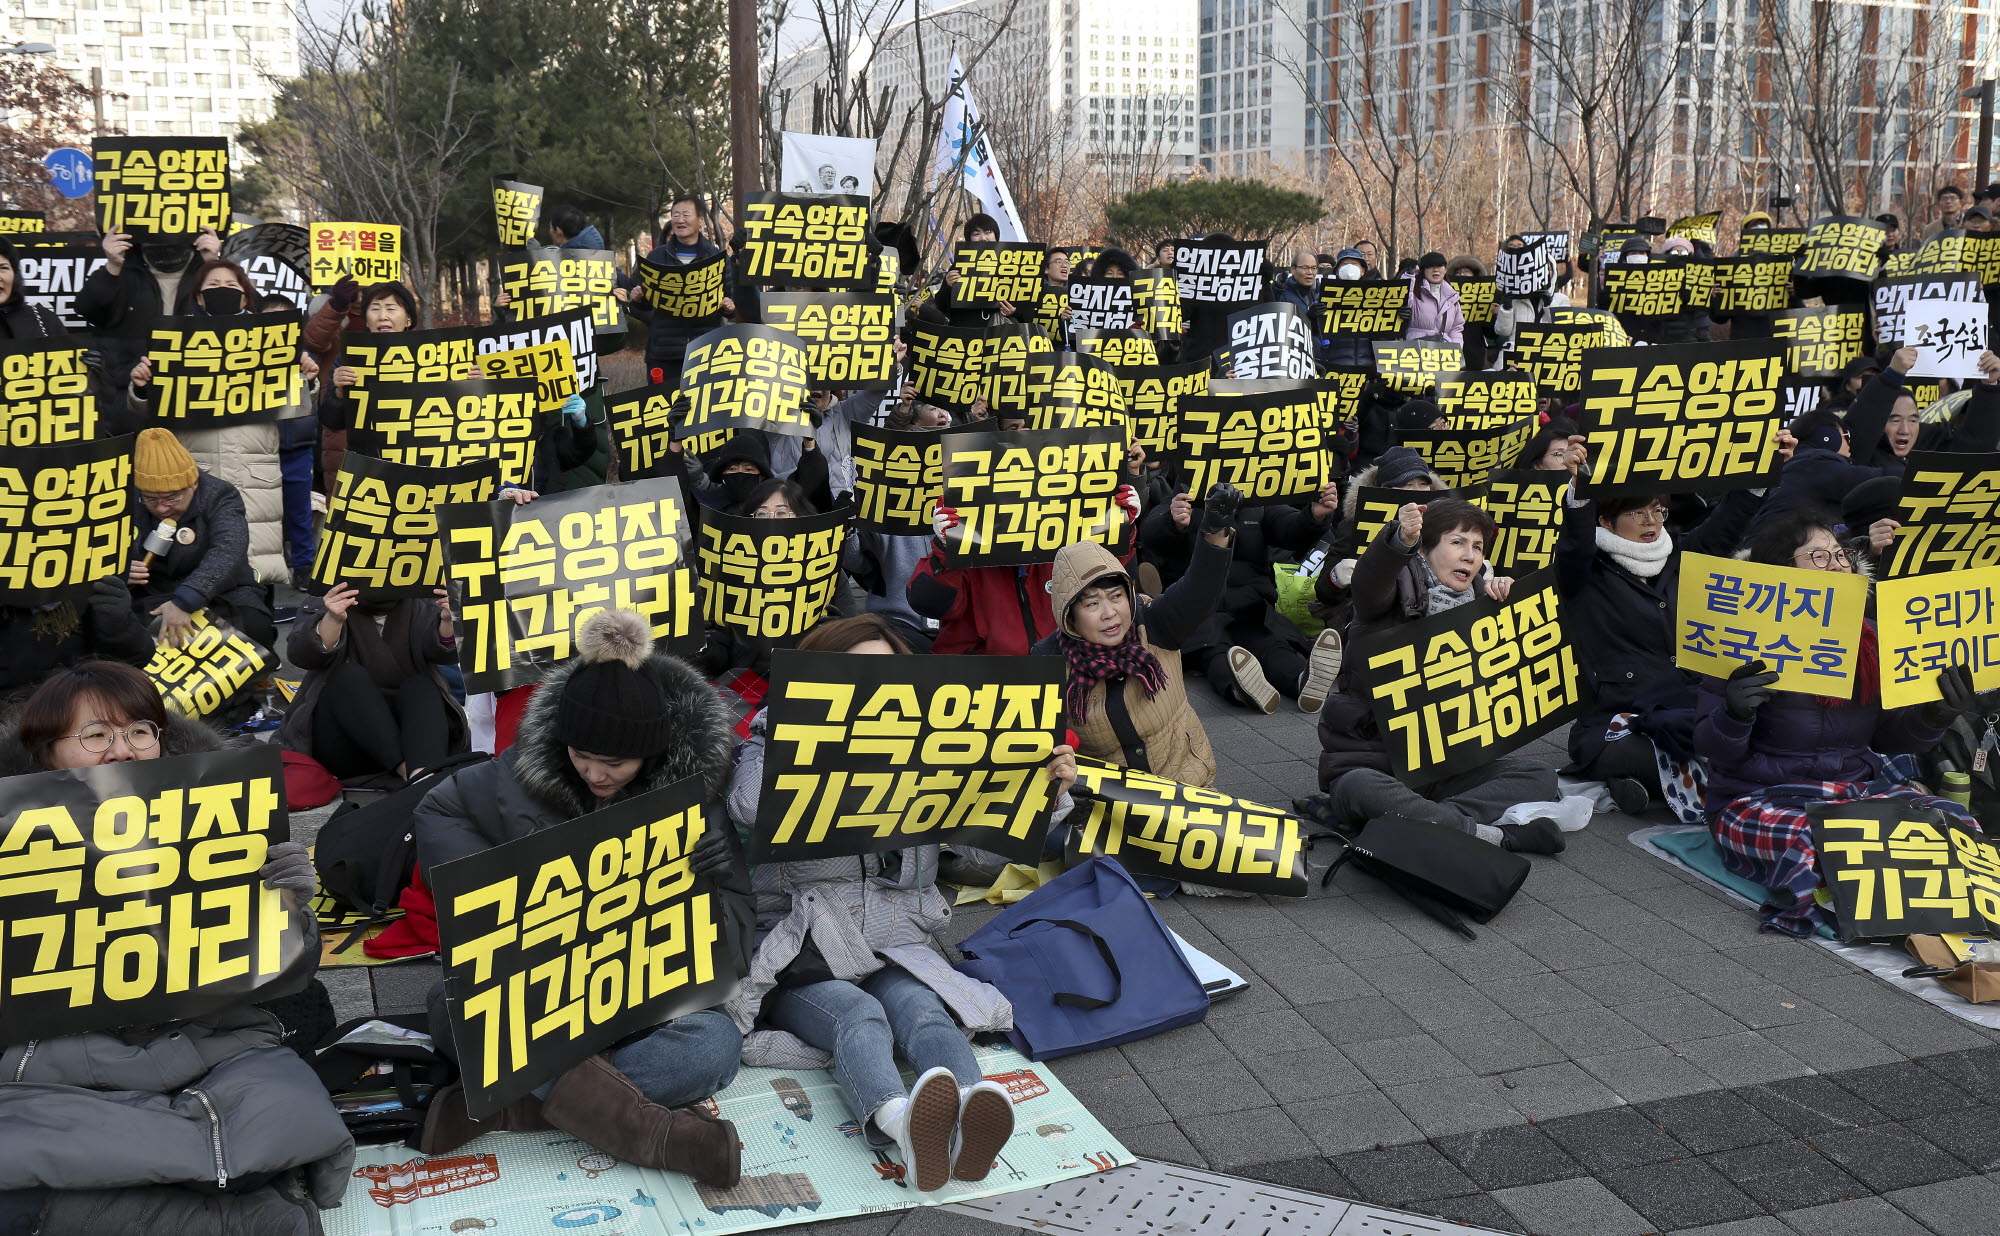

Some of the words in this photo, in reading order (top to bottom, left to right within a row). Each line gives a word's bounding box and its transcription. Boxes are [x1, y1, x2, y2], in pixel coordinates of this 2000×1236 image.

[95, 150, 227, 191] 구속영장
[98, 192, 231, 234] 기각하라
[744, 203, 869, 242] 구속영장
[316, 229, 395, 251] 윤석열을
[1497, 243, 1548, 274] 억지수사
[1740, 232, 1807, 254] 구속영장
[1806, 222, 1887, 253] 구속영장
[314, 257, 399, 282] 수사하라!
[504, 259, 615, 298] 구속영장
[639, 258, 726, 296] 구속영장
[746, 242, 869, 280] 기각하라
[955, 249, 1045, 277] 구속영장
[1176, 246, 1264, 275] 억지수사
[1605, 268, 1686, 293] 구속영장
[1716, 261, 1793, 287] 구속영장
[1800, 246, 1881, 277] 기각하라
[641, 286, 725, 319] 기각하라
[957, 276, 1043, 303] 기각하라
[1177, 274, 1263, 303] 중단하라
[1320, 285, 1409, 309] 구속영장
[1451, 280, 1496, 303] 영장
[1608, 290, 1683, 316] 기각하라
[1720, 286, 1790, 311] 기각하라
[765, 304, 894, 343] 구속영장
[1231, 312, 1314, 349] 억지수사
[1323, 308, 1402, 334] 기각하라
[1773, 312, 1865, 343] 구속영장
[148, 323, 301, 373] 구속영장
[345, 339, 475, 387] 구속영장
[486, 347, 563, 379] 우리가
[683, 337, 808, 386] 구속영장
[1234, 346, 1317, 380] 중단하라
[1378, 348, 1462, 372] 구속영장
[0, 349, 88, 400] 영장
[153, 365, 304, 418] 기각하라
[1027, 365, 1126, 412] 구속영장
[1584, 356, 1783, 426] 구속영장
[375, 392, 537, 445] 구속영장
[612, 389, 680, 438] 구속
[683, 377, 811, 428] 기각하라
[1438, 381, 1538, 414] 구속영장
[0, 396, 98, 447] 하라
[1181, 402, 1321, 456] 구속영장
[947, 442, 1126, 502] 구속영장
[1586, 418, 1781, 485] 기각하라
[1183, 449, 1330, 502] 기각하라
[956, 496, 1127, 555] 기각하라
[450, 498, 682, 598] 구속영장
[700, 523, 846, 585] 구속영장
[462, 568, 696, 674] 기각하라
[700, 570, 839, 639] 기각하라
[1704, 572, 1835, 628] 끝까지
[1904, 586, 1995, 635] 우리가
[1368, 586, 1563, 711] 구속영장
[1682, 619, 1848, 679] 조국수호
[774, 681, 1063, 766] 구속영장
[1388, 645, 1580, 772] 기각하라
[771, 766, 1053, 844] 기각하라
[1077, 799, 1303, 879] 기각하라
[452, 803, 706, 985] 구속영장
[0, 880, 289, 1008] 각하라
[464, 893, 718, 1089] 기각하라
